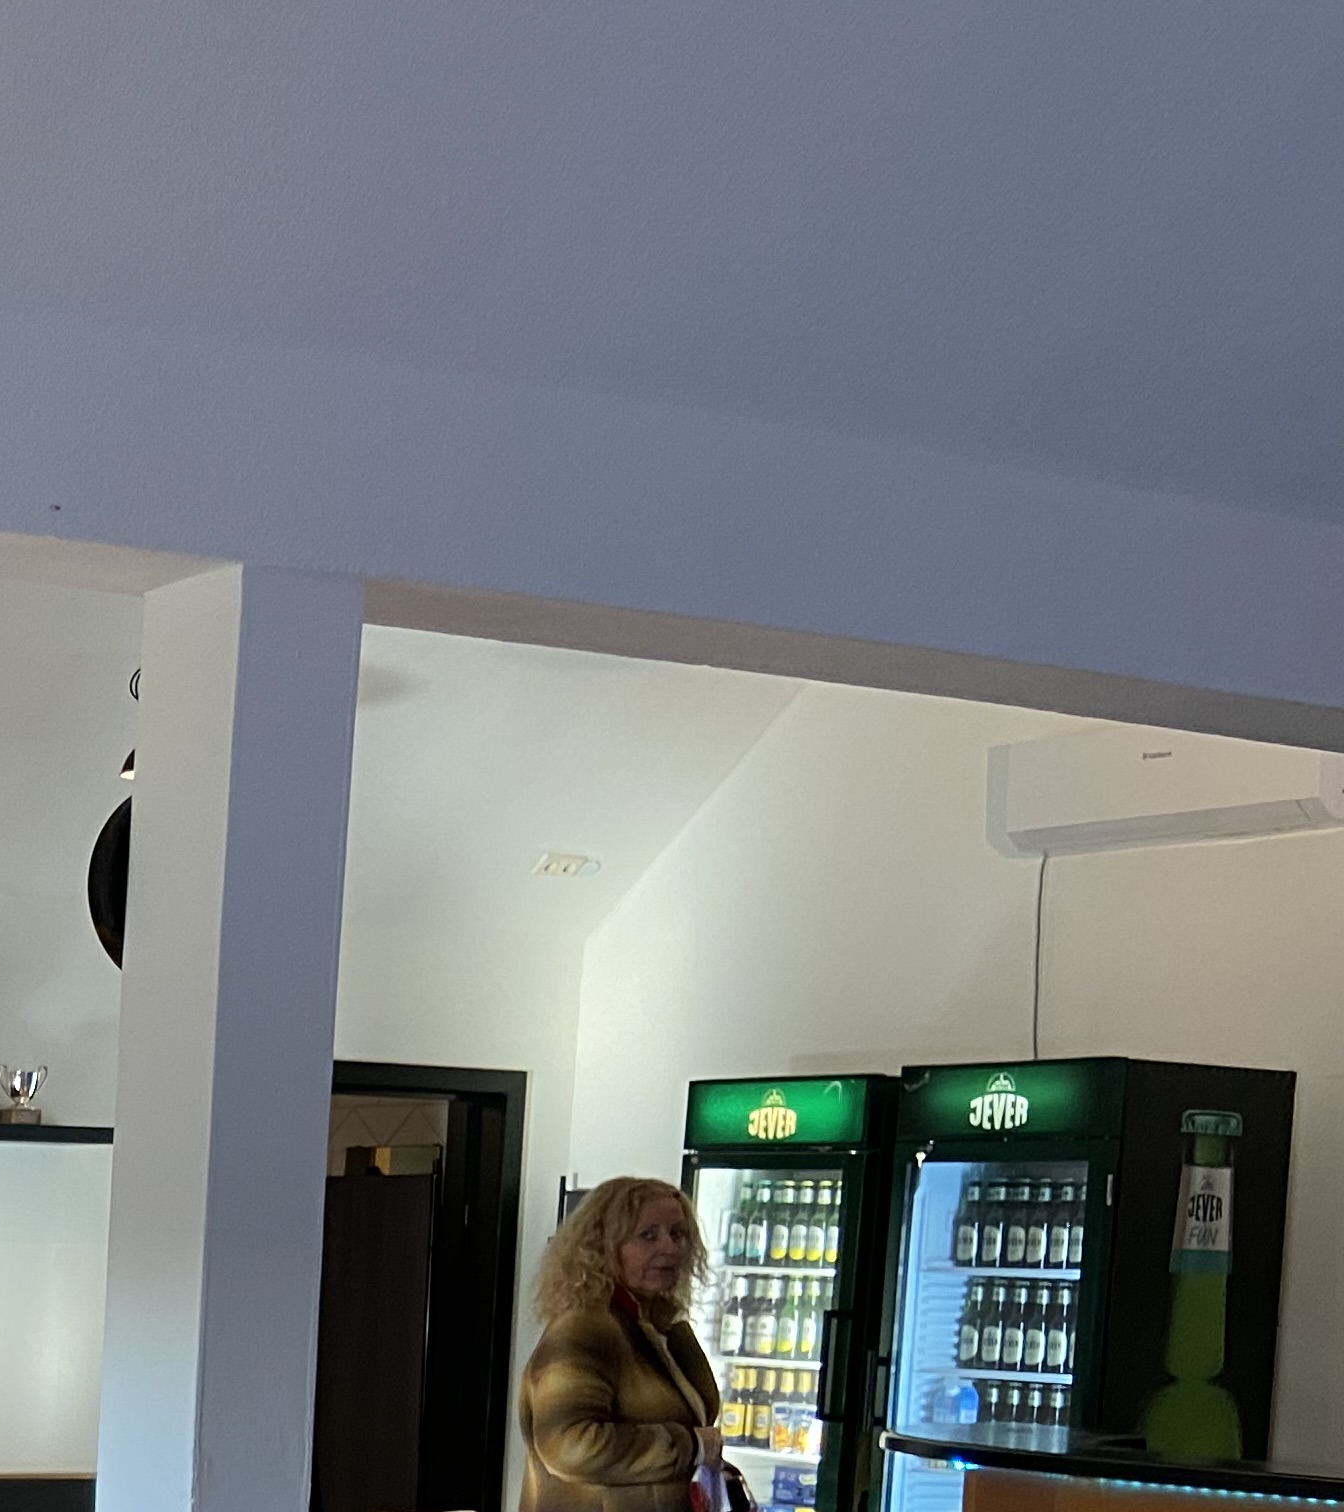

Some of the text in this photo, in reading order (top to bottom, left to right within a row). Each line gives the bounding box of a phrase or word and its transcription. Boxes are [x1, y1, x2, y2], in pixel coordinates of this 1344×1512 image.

[748, 1107, 797, 1140] JEVER
[969, 1093, 1029, 1130] JEVER
[1188, 1194, 1223, 1222] JEVER
